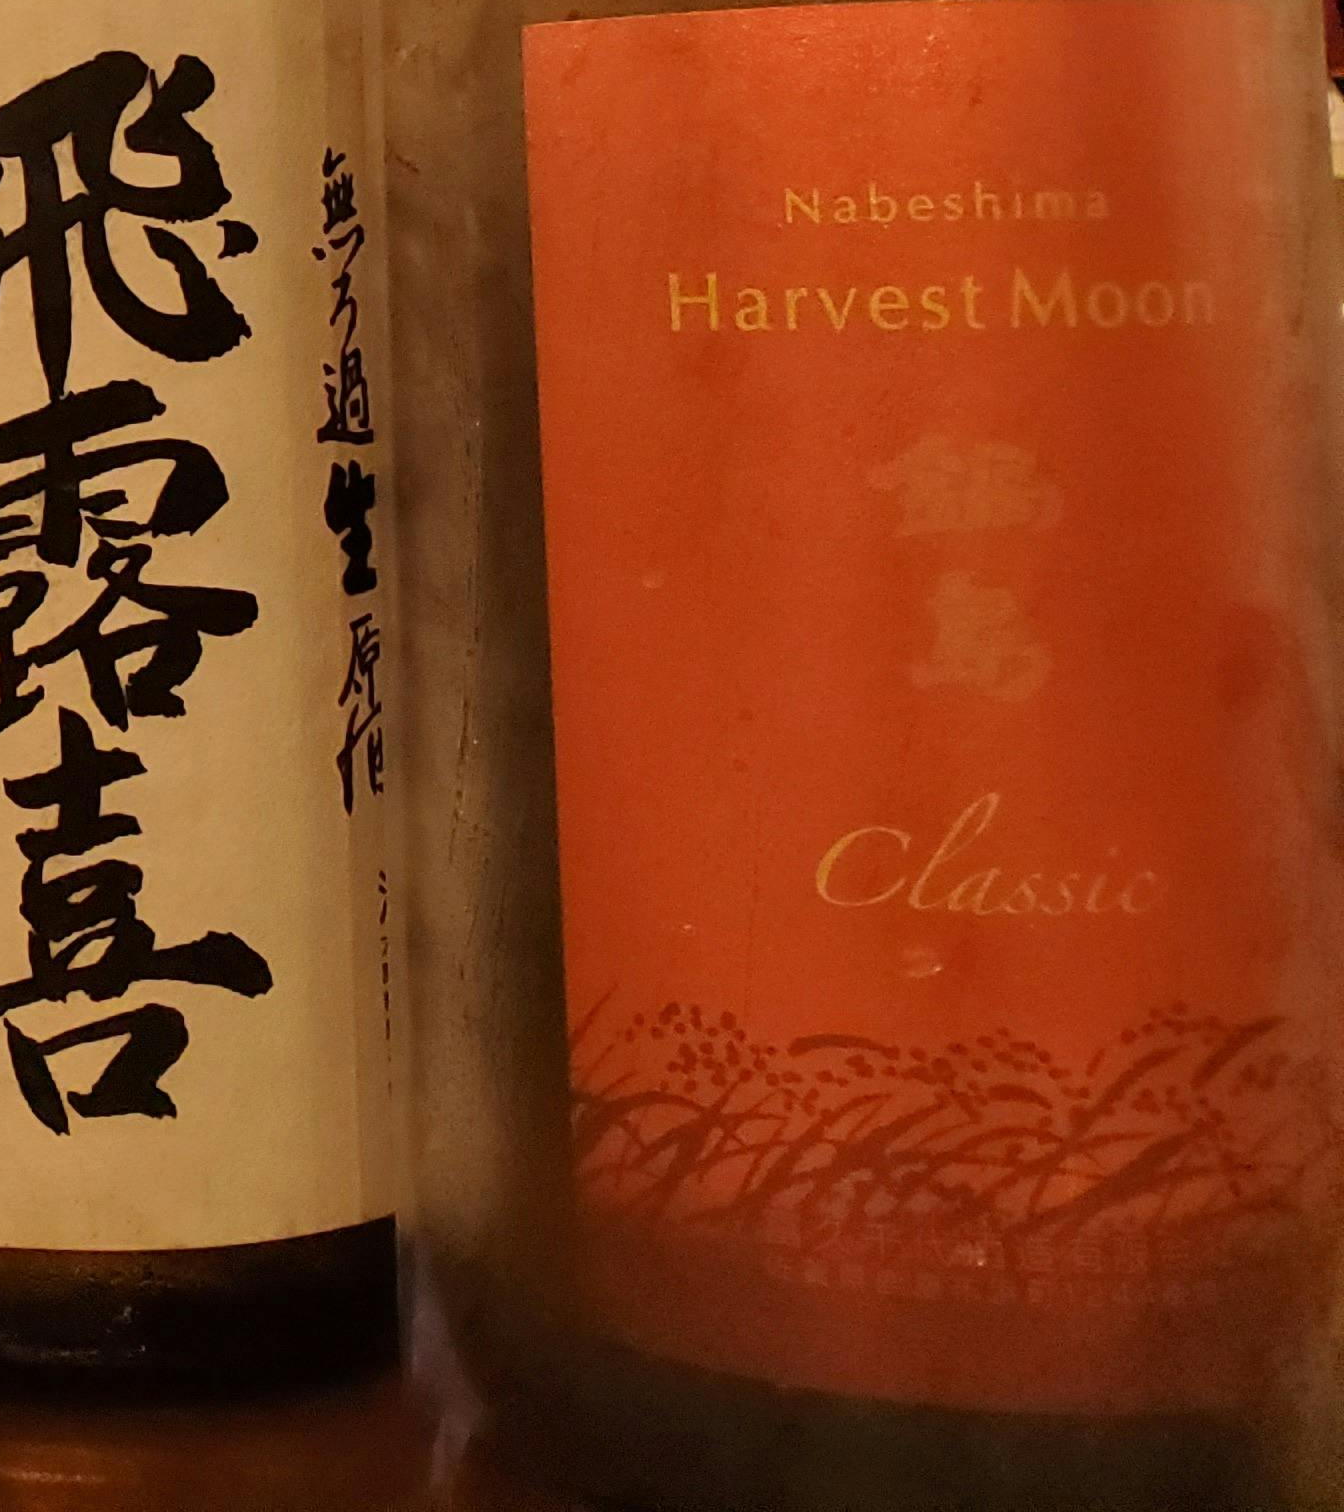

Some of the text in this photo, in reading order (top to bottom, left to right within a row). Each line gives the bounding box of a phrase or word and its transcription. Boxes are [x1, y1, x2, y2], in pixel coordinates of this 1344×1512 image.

[784, 181, 1111, 227] Nabeshima
[667, 266, 1217, 333] Harvest Moon
[815, 792, 1160, 916] Classic
